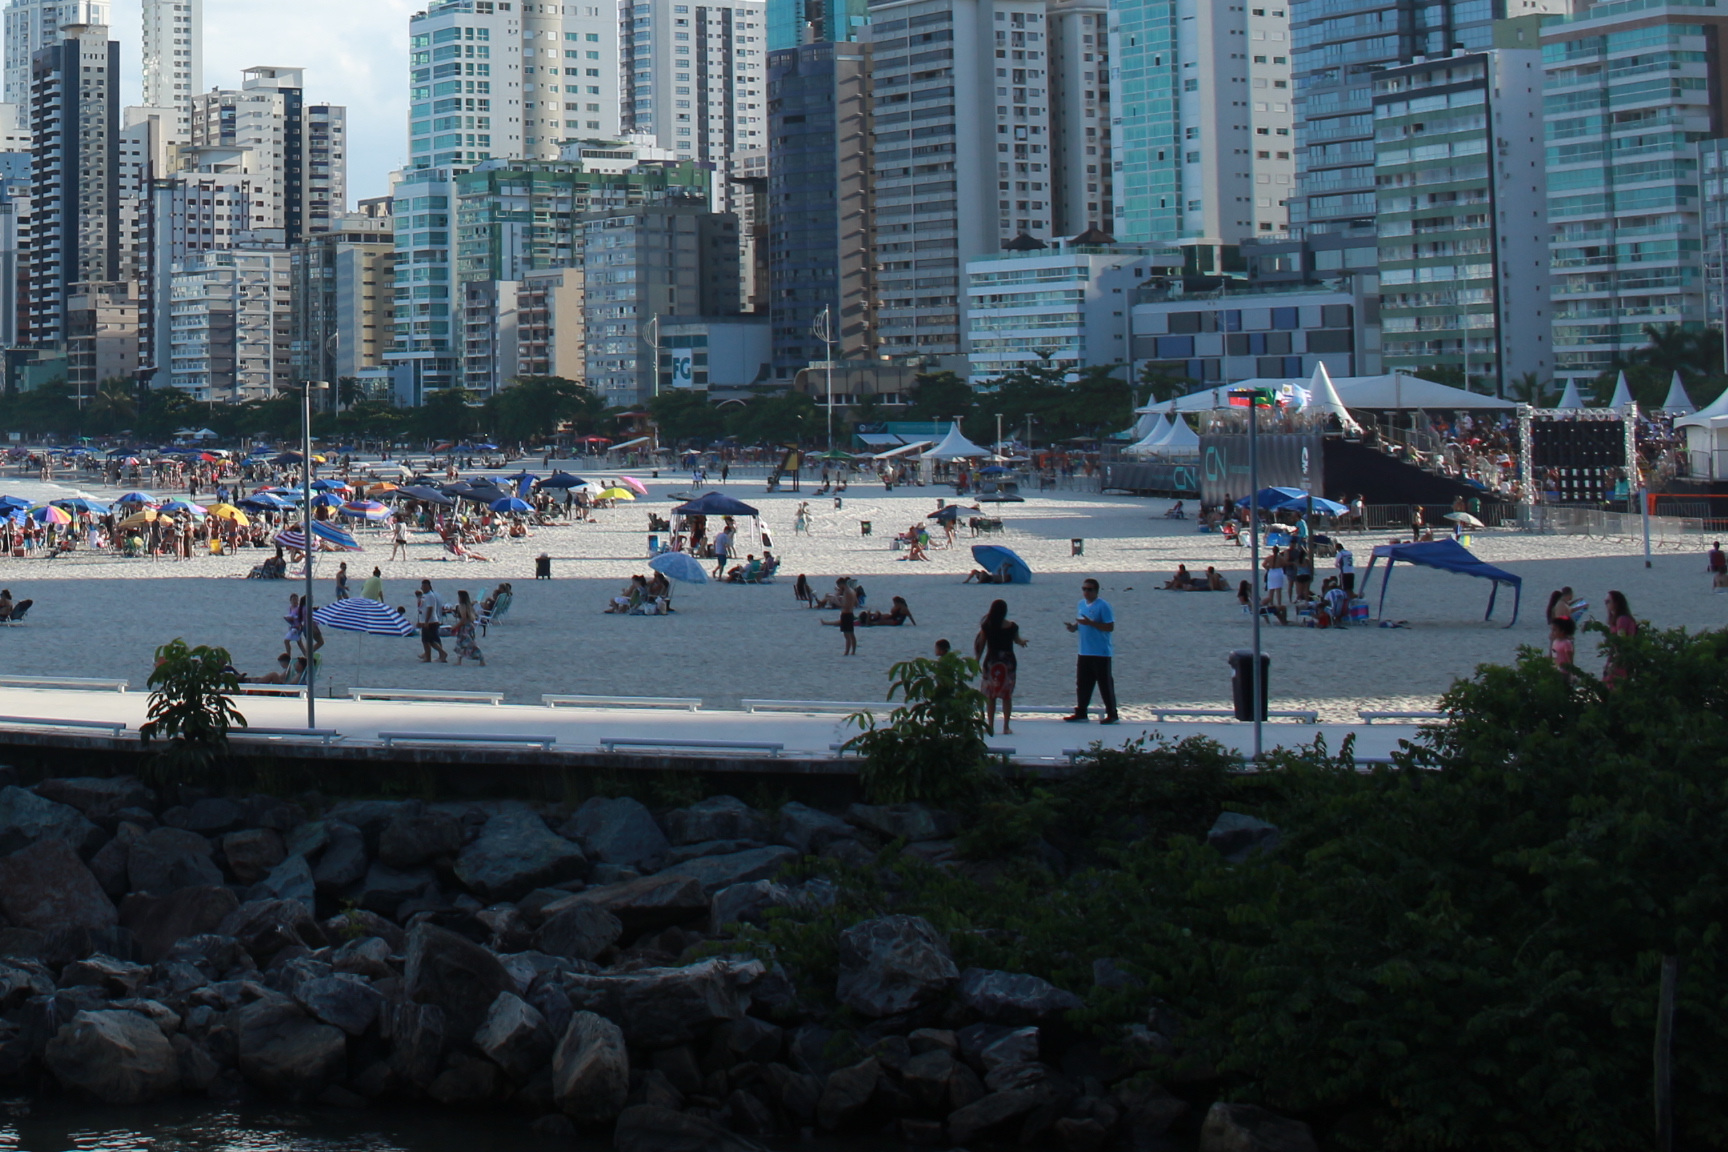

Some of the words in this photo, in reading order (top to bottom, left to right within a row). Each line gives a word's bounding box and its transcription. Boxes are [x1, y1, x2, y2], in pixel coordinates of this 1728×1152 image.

[673, 357, 691, 380] FG
[1205, 446, 1227, 481] CN
[1173, 466, 1196, 490] CN
